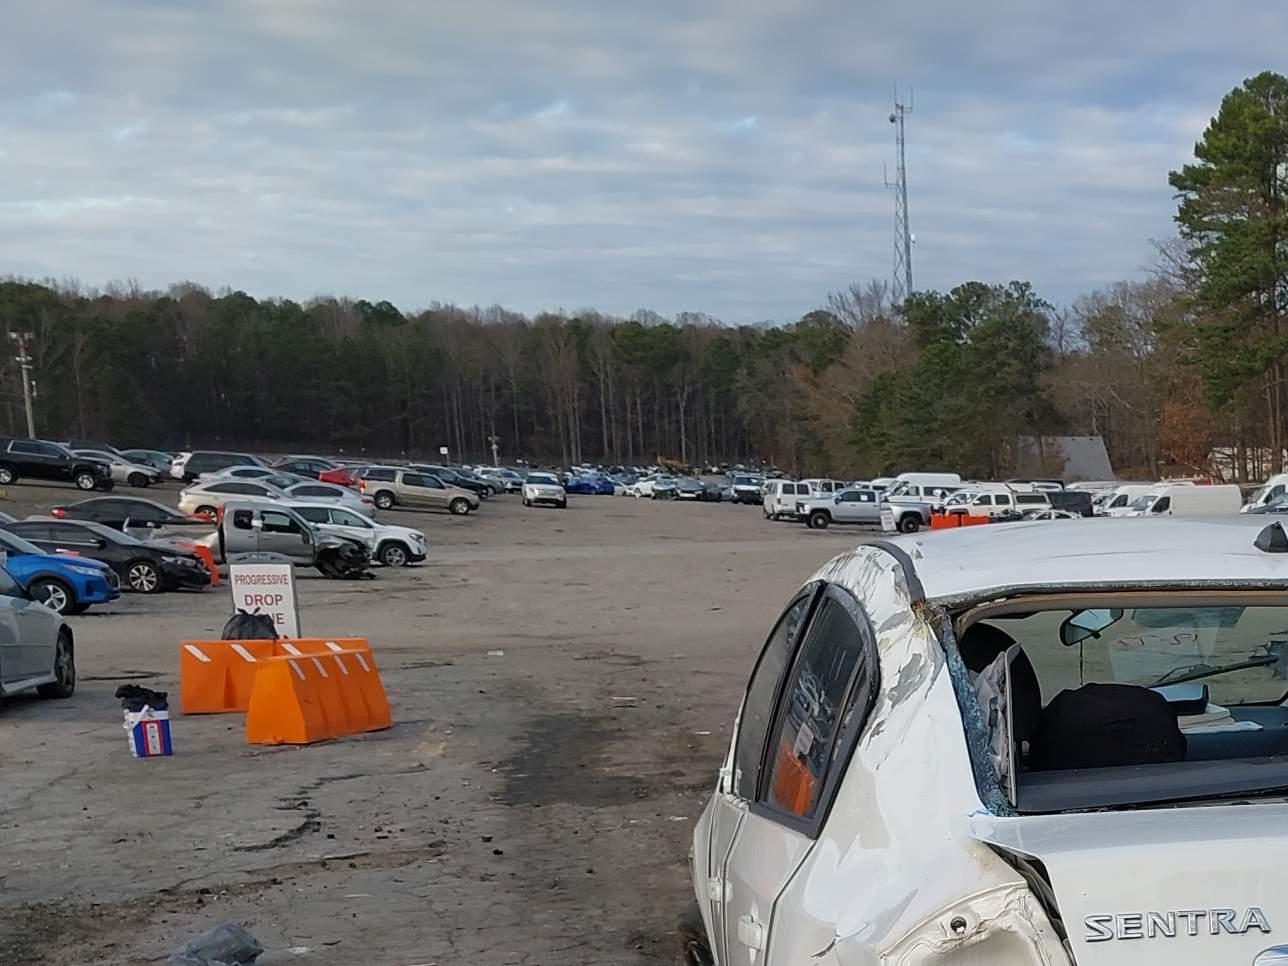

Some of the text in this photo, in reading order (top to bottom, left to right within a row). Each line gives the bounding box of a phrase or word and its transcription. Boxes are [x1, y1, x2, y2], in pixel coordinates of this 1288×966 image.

[234, 574, 289, 585] PROGRESSIVE
[244, 594, 283, 606] DROP
[1084, 907, 1272, 943] SENTRA
